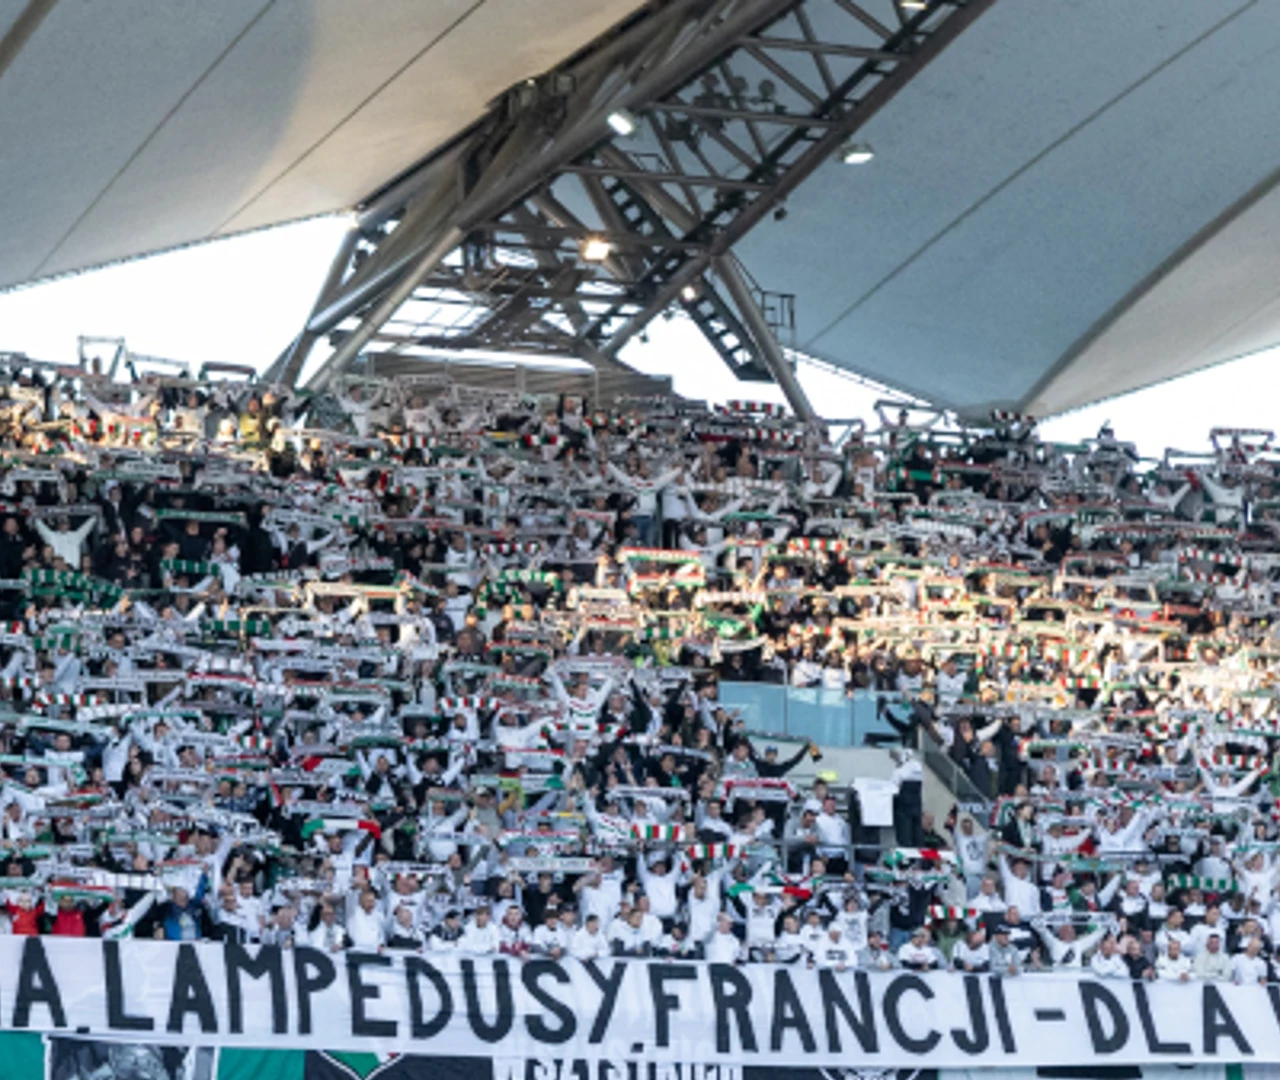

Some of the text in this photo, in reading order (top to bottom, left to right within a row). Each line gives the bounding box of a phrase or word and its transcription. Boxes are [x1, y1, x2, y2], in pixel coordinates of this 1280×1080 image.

[647, 963, 1016, 1056] FRANCJI
[1035, 1007, 1066, 1021] -
[1078, 980, 1254, 1054] DLA
